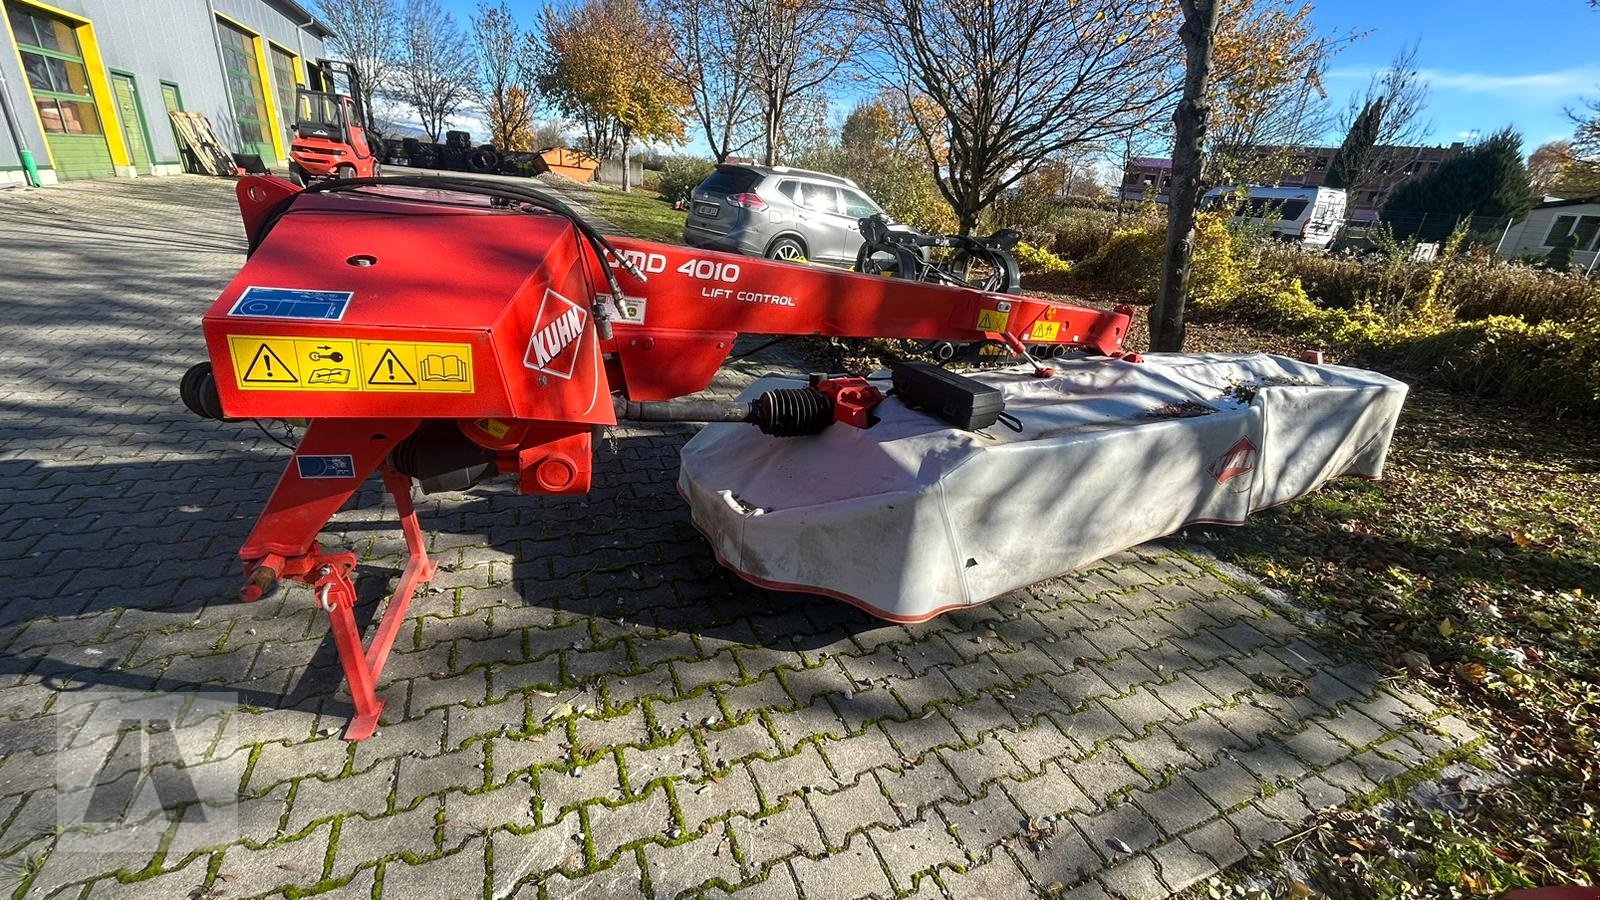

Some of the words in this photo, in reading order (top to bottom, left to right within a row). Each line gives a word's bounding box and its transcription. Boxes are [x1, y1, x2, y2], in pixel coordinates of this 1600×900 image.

[676, 259, 740, 282] 4010
[701, 287, 733, 299] LIFT
[737, 291, 796, 306] CONTROL
[531, 305, 582, 369] KUHN
